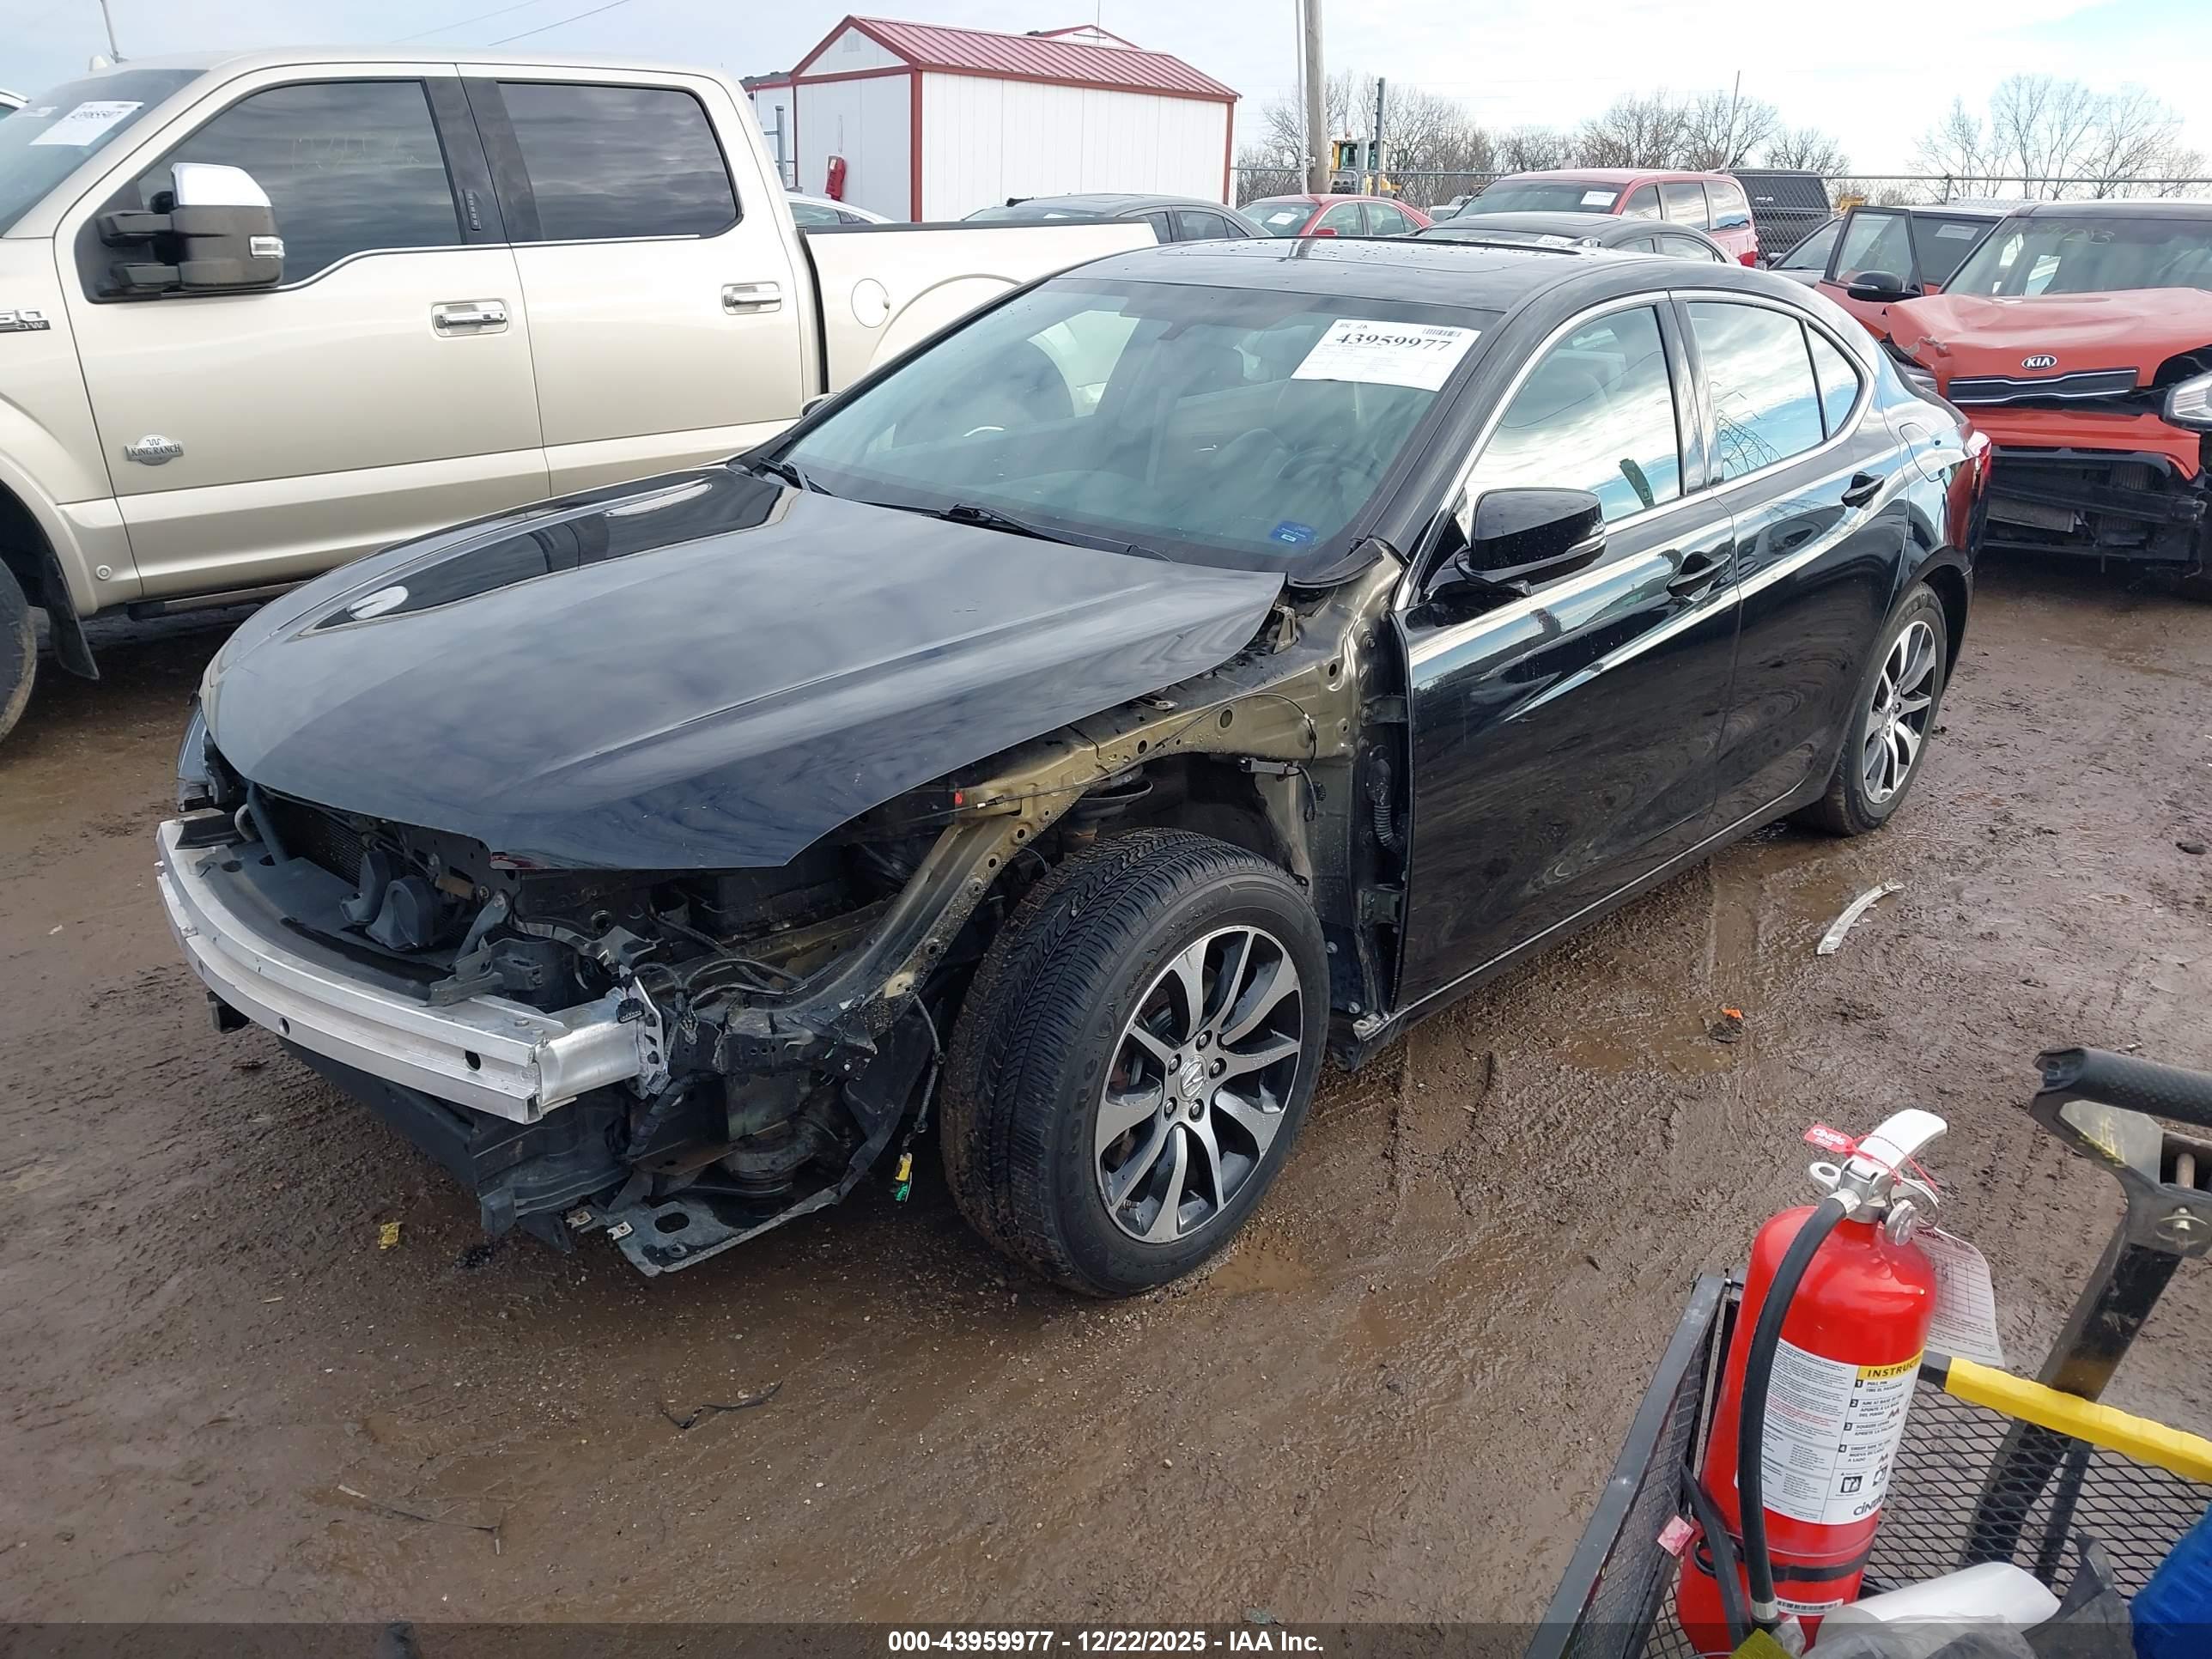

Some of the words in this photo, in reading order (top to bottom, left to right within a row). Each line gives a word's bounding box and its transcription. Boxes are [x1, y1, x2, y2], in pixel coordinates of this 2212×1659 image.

[1336, 332, 1453, 351] 43959977
[2027, 356, 2051, 368] KIA
[130, 447, 152, 456] KING
[153, 443, 180, 455] RANCH
